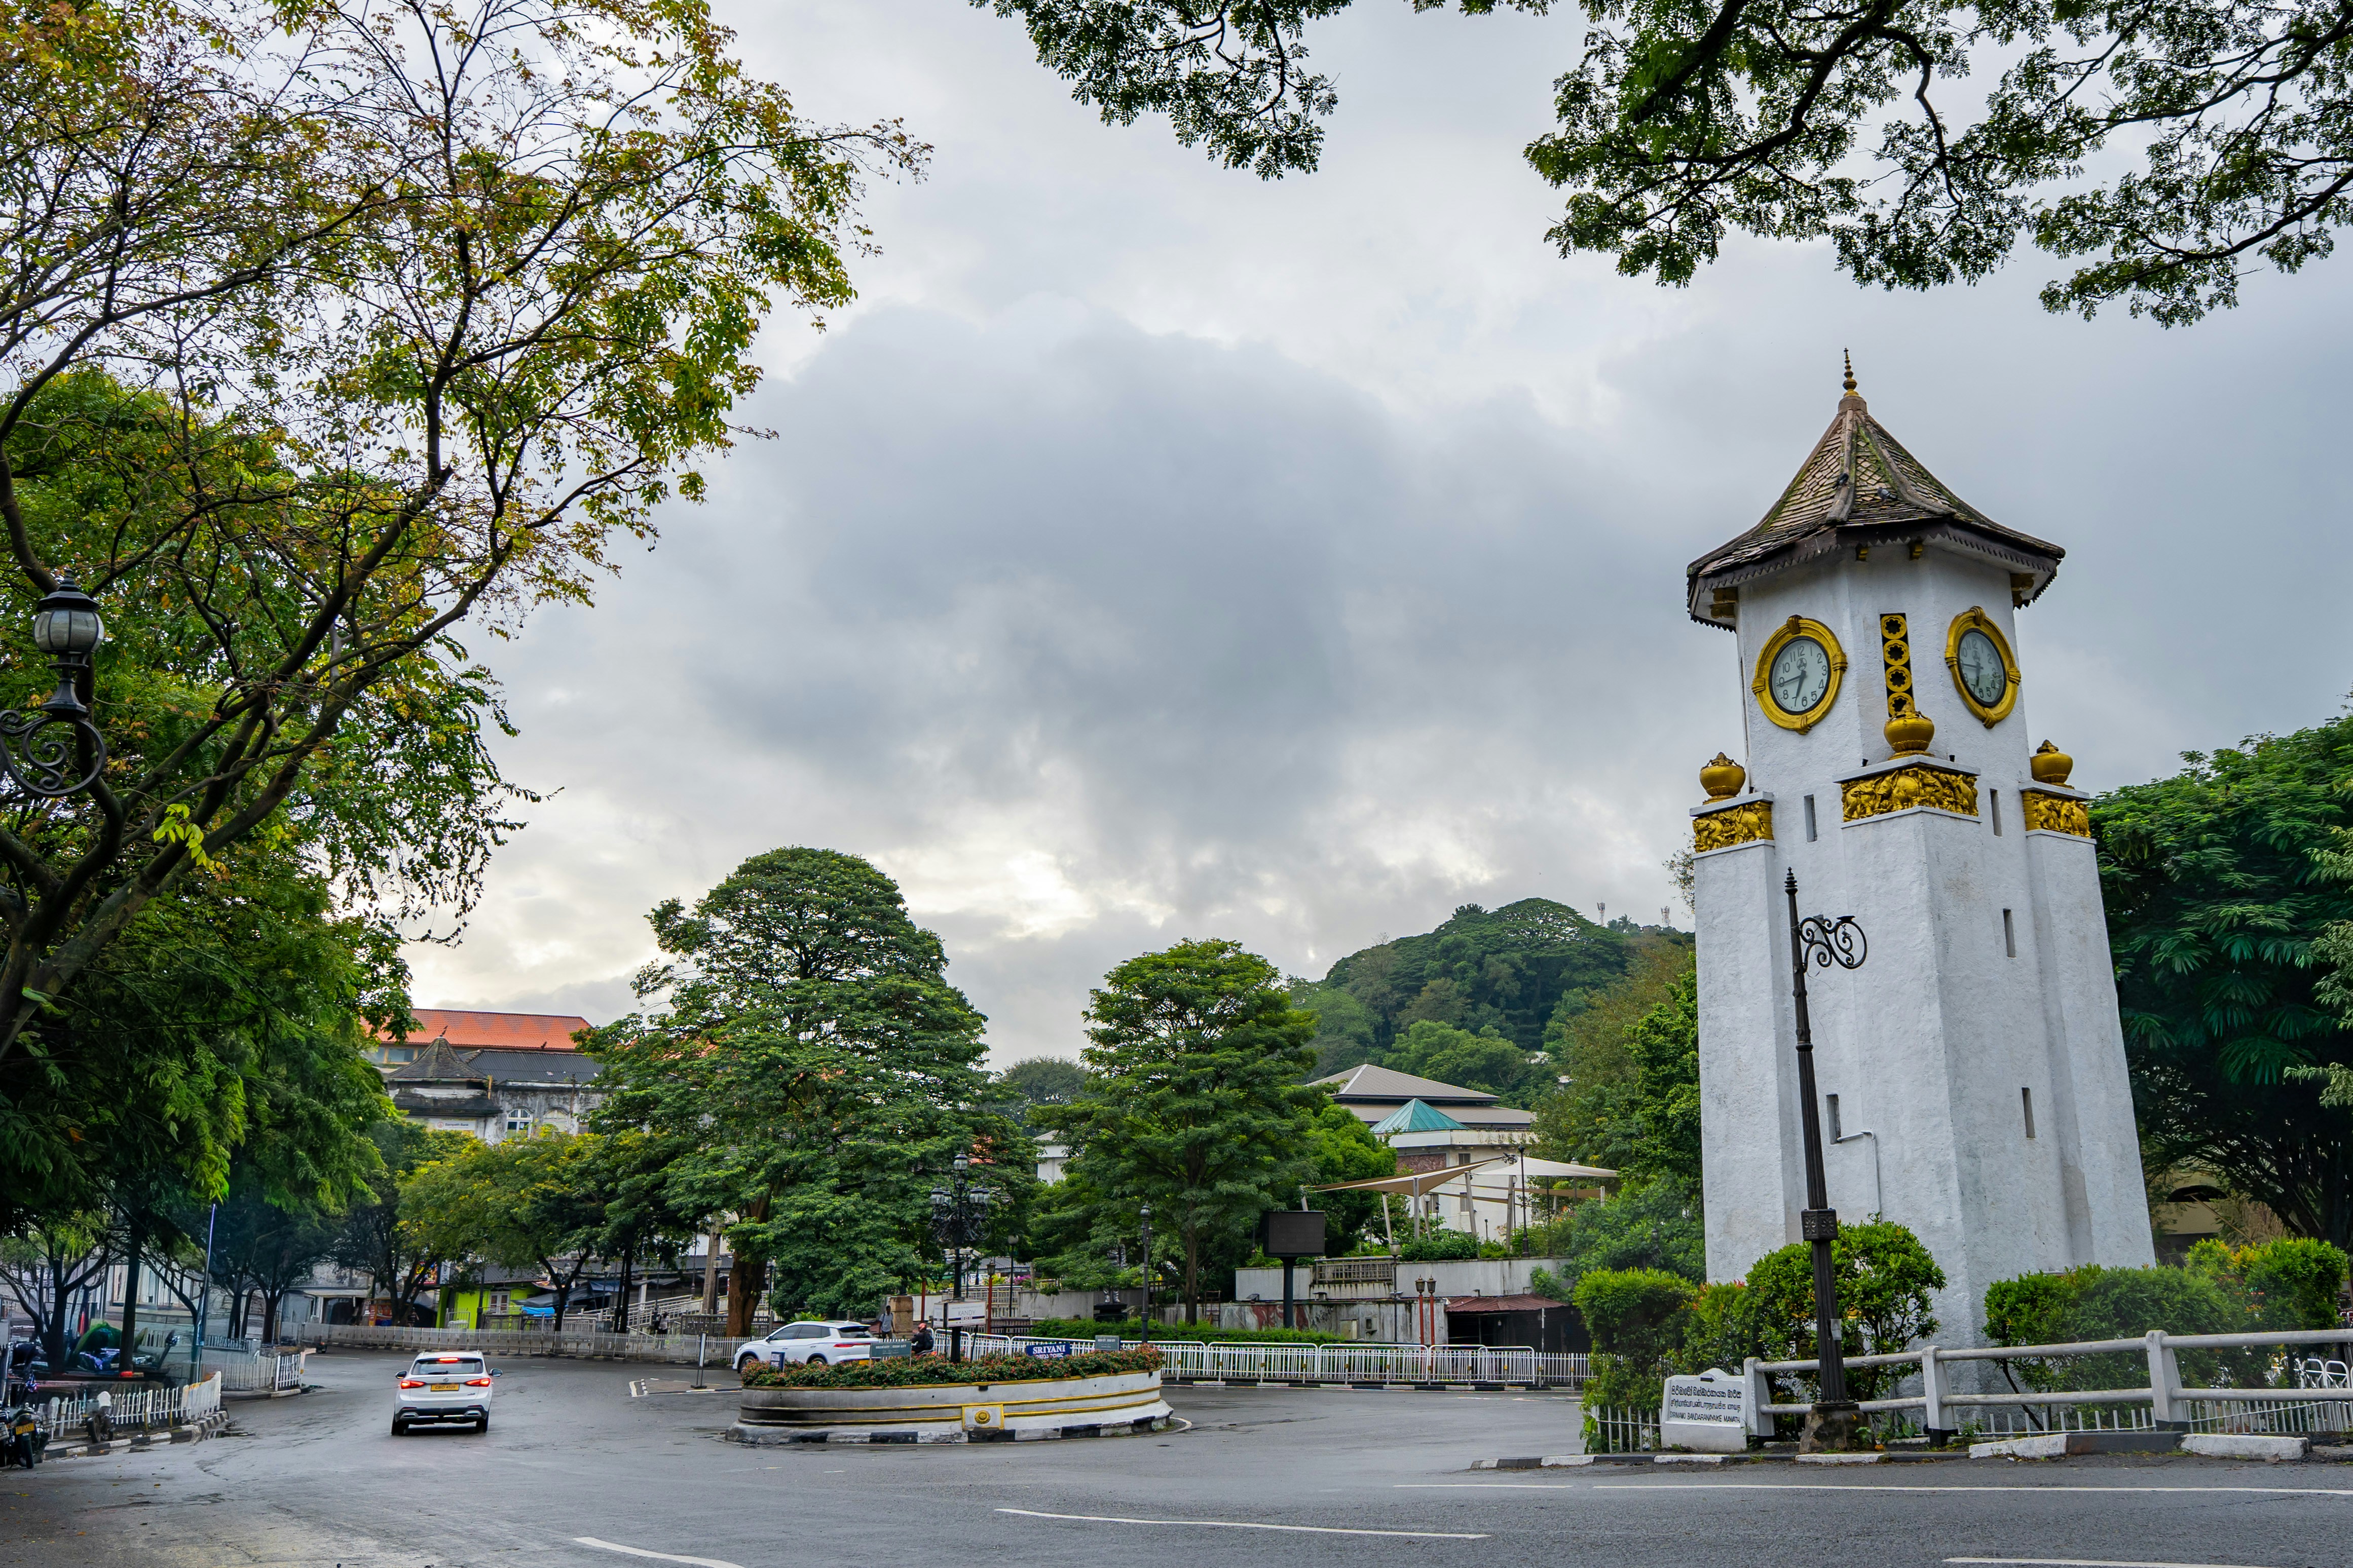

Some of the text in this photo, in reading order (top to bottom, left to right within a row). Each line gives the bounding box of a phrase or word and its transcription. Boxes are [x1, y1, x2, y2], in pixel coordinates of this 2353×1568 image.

[1966, 640, 1971, 651] 11
[1971, 639, 1978, 649] 12
[1981, 643, 1984, 654] 1
[1790, 651, 1796, 662] 11
[1798, 645, 1805, 657] 12
[1810, 646, 1812, 657] 1
[1961, 647, 1967, 658] 10
[1817, 653, 1822, 664] 2
[1987, 654, 1992, 664] 2
[1783, 662, 1790, 674] 10
[1821, 665, 1827, 676] 3
[1779, 677, 1784, 687] 9
[1818, 679, 1824, 690] 4
[1991, 680, 1998, 690] 4
[1971, 684, 1975, 693] 7
[1986, 687, 1992, 697] 5
[1783, 690, 1788, 700] 8
[1811, 691, 1817, 701] 5
[1792, 697, 1798, 707] 7
[1802, 696, 1808, 707] 6
[1033, 1345, 1066, 1354] SRIYANI
